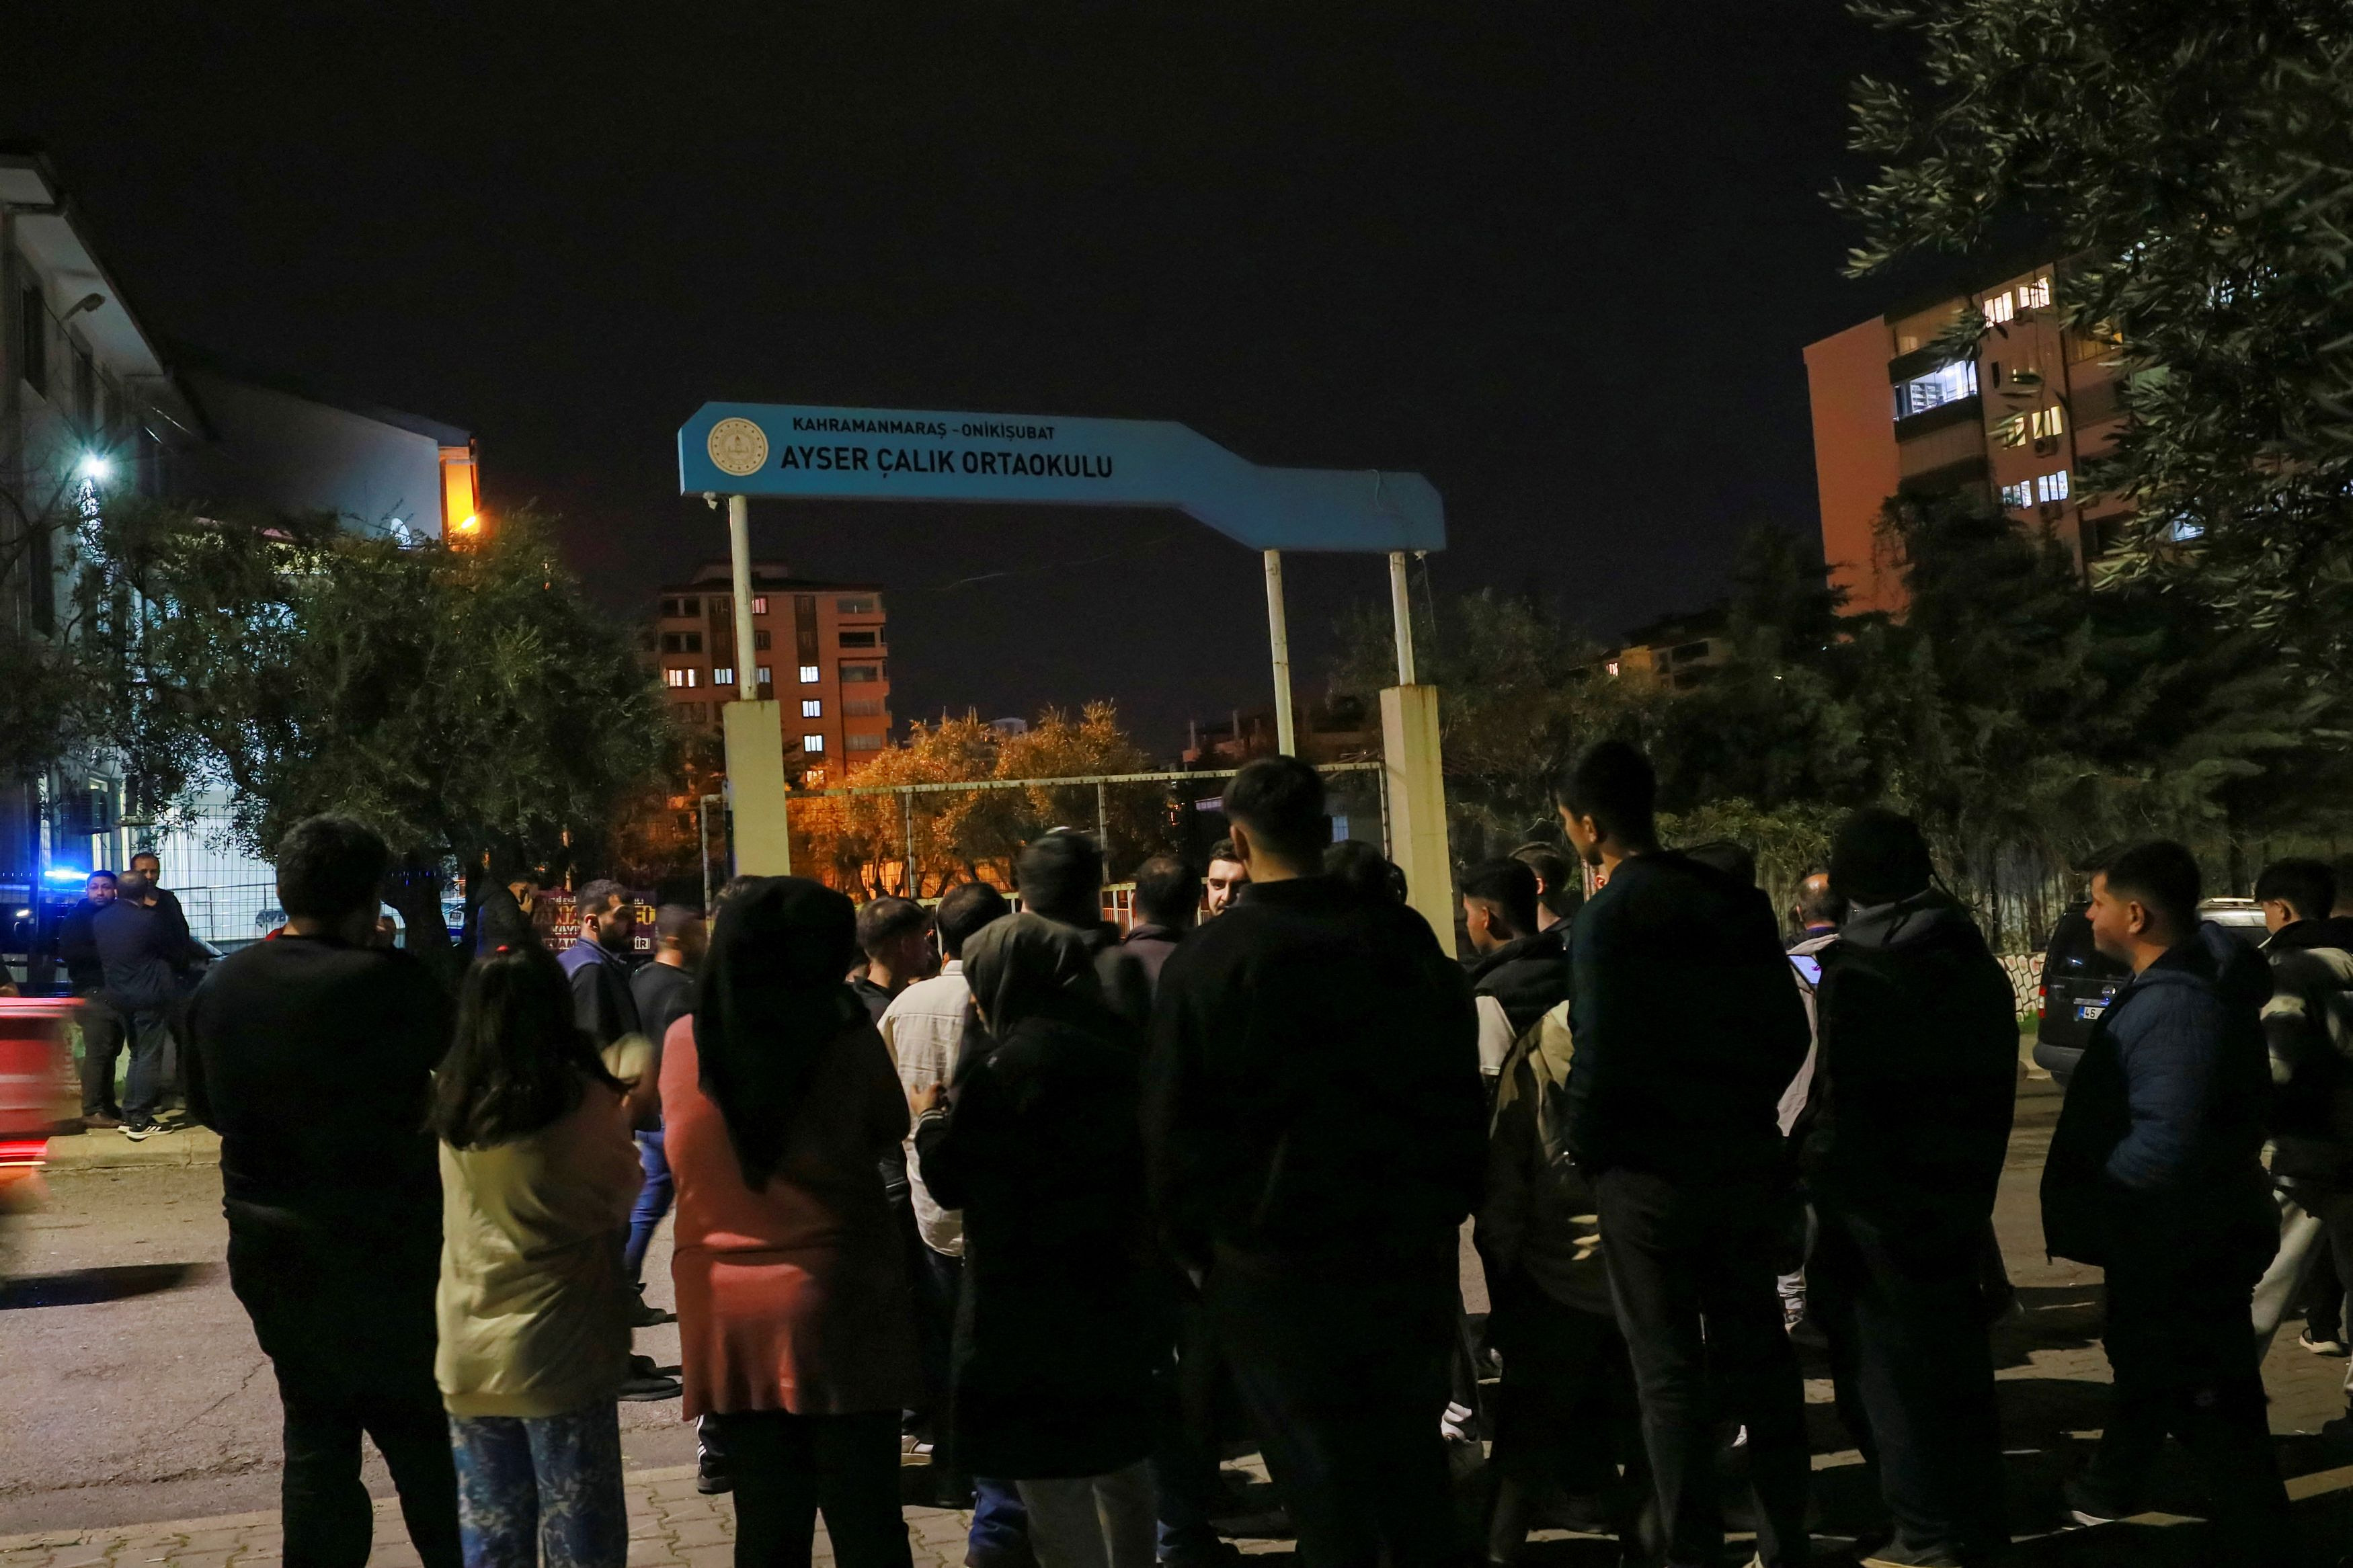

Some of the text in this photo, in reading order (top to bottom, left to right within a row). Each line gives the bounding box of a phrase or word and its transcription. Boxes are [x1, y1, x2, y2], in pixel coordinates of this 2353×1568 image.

[793, 417, 947, 439] KAHRAMANMARAŞ
[961, 421, 1055, 441] ONİKİŞUBAT
[781, 446, 1113, 479] AYSER ÇALIK ORTAOKULU
[2085, 1008, 2096, 1018] 46
